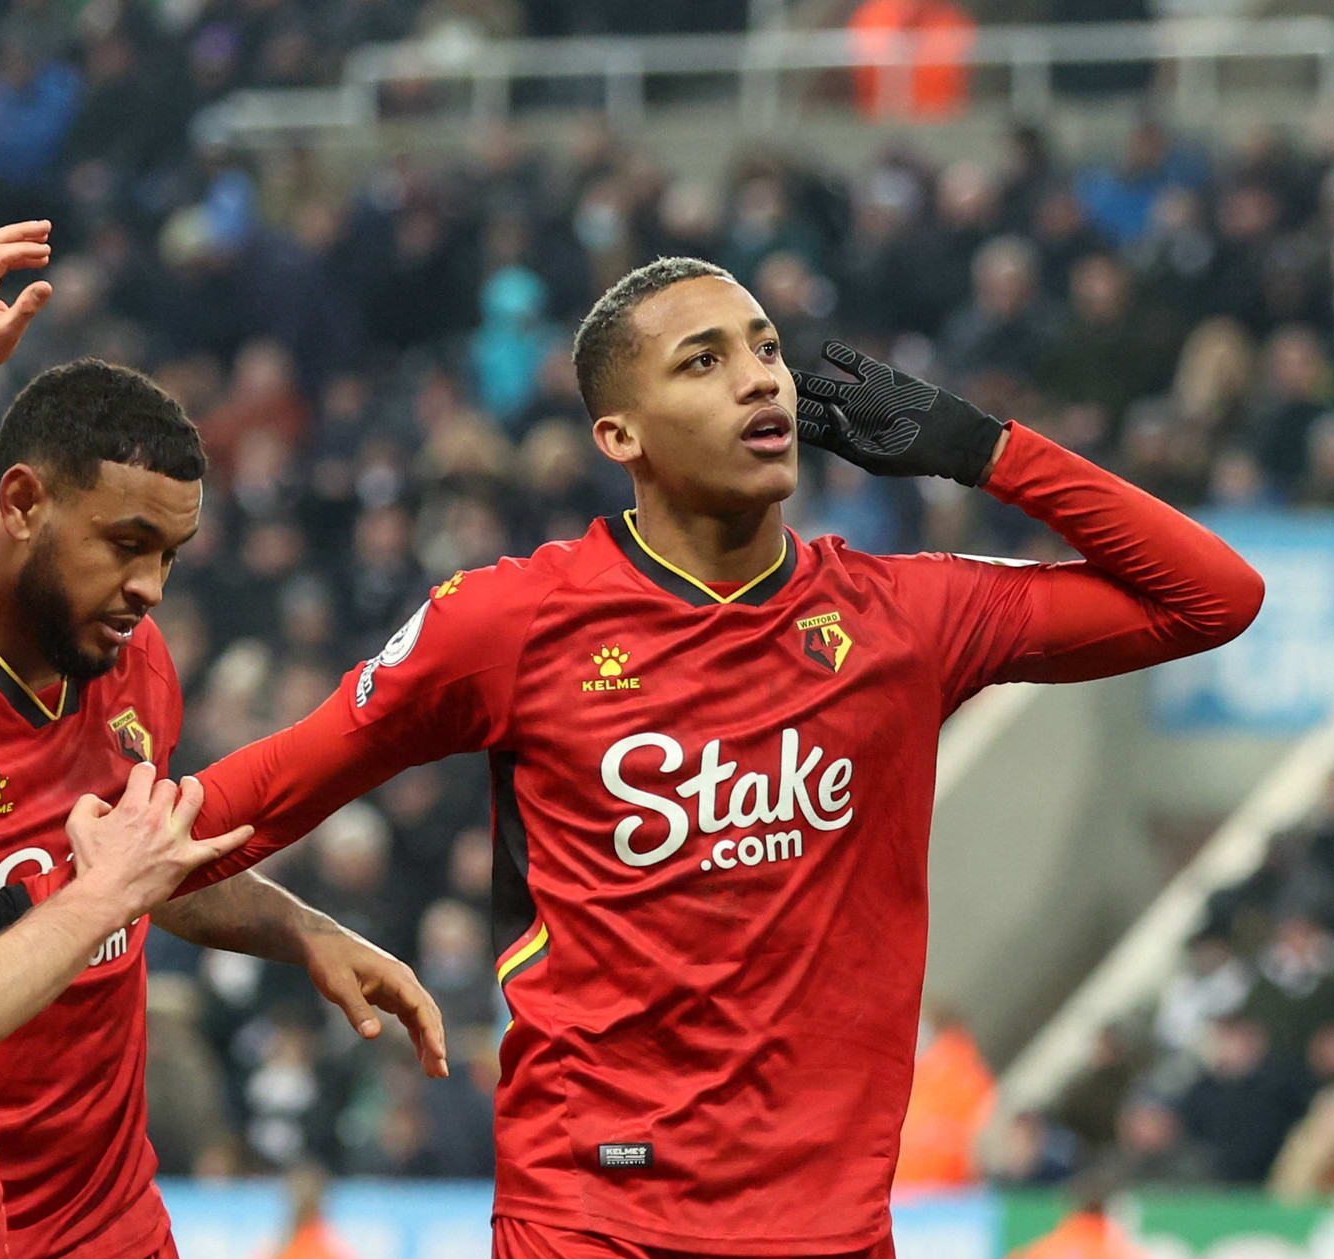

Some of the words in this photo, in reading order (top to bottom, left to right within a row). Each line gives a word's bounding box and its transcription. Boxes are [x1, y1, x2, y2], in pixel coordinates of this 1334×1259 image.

[799, 614, 838, 629] WATFORD
[582, 677, 641, 692] KELME
[600, 727, 854, 867] Stake
[700, 829, 804, 872] .com
[606, 1147, 639, 1155] KELME
